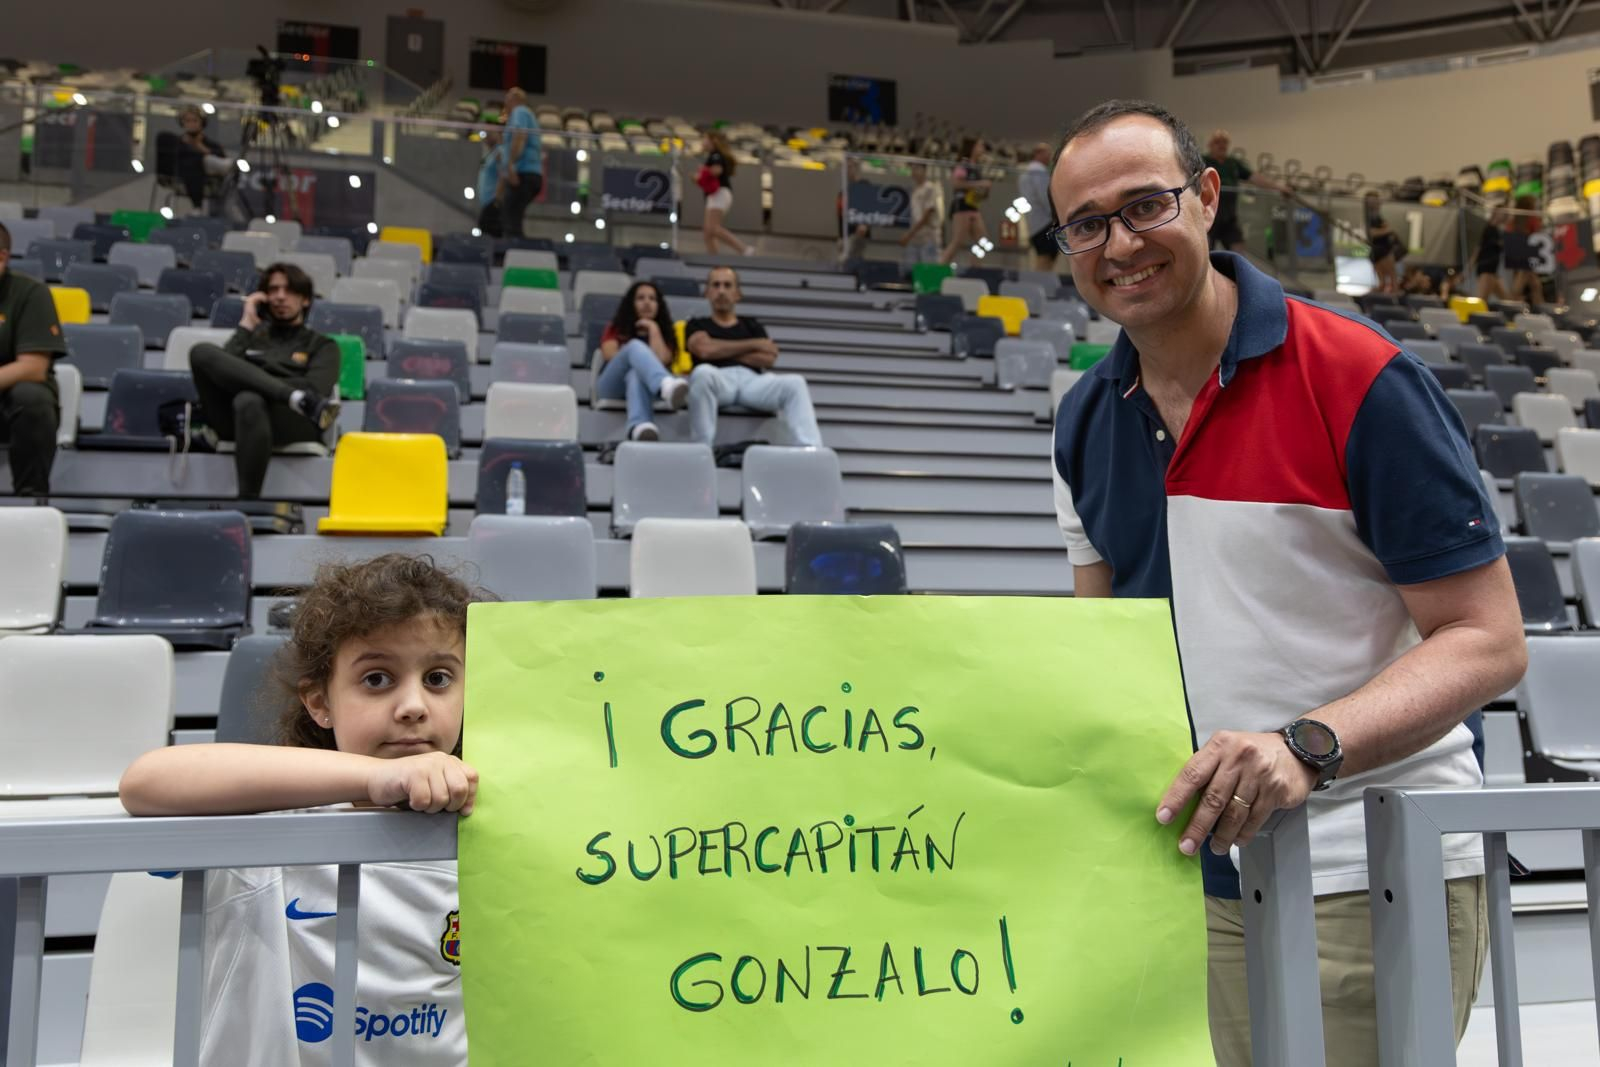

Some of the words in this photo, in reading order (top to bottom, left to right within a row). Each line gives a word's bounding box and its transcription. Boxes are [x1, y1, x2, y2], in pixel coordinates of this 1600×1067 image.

[601, 192, 655, 212] Sector
[634, 166, 671, 208] 2
[847, 207, 896, 225] Sector
[1527, 231, 1556, 274] 3
[575, 804, 966, 886] SUPERCAPITÁN
[355, 1003, 448, 1041] Spotify
